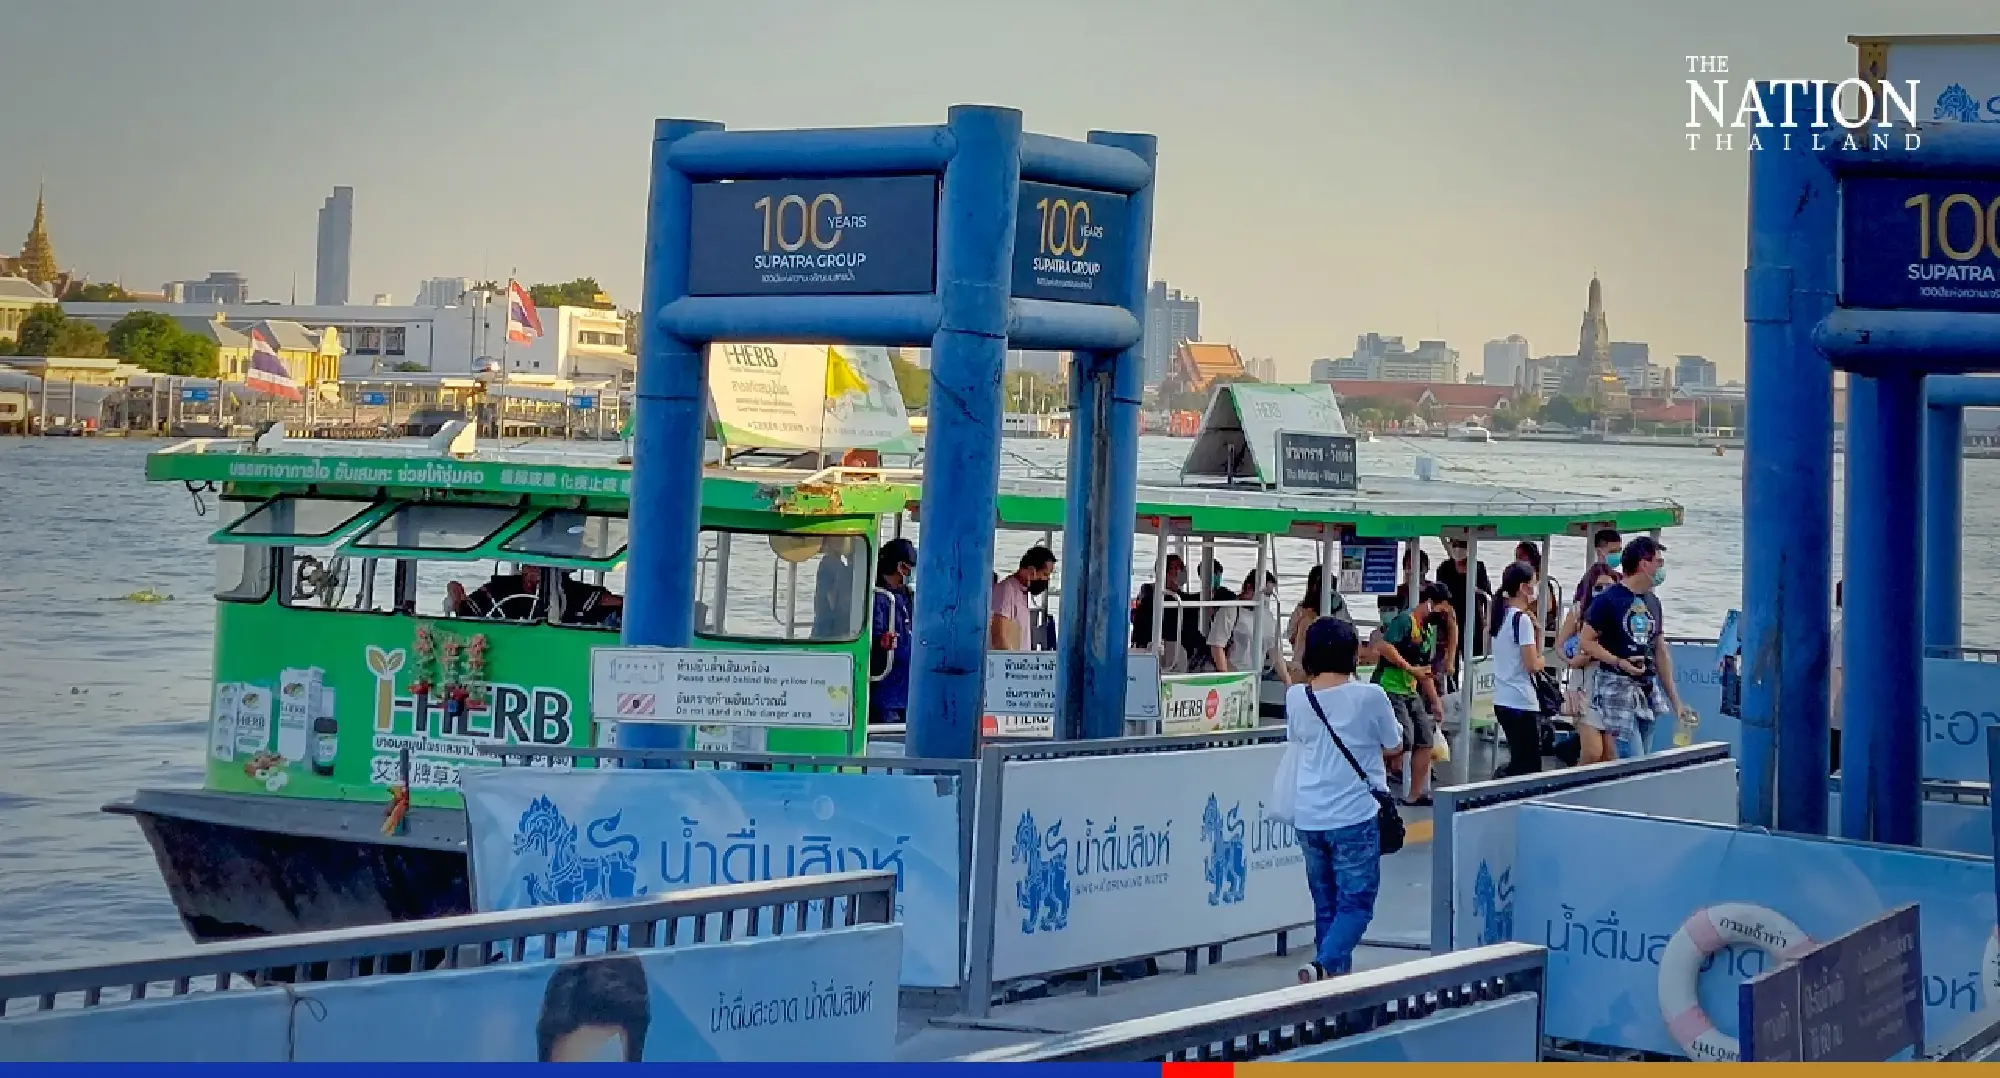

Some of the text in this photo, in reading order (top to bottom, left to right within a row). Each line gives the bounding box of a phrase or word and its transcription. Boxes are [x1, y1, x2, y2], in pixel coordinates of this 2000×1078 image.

[755, 193, 842, 251] 100
[828, 215, 867, 228] YEARS
[1037, 198, 1090, 257] 100
[755, 253, 867, 268] SUPATRA GROUP
[1033, 258, 1101, 277] SUPATRA GROUP
[1908, 264, 1996, 281] SUPATRA
